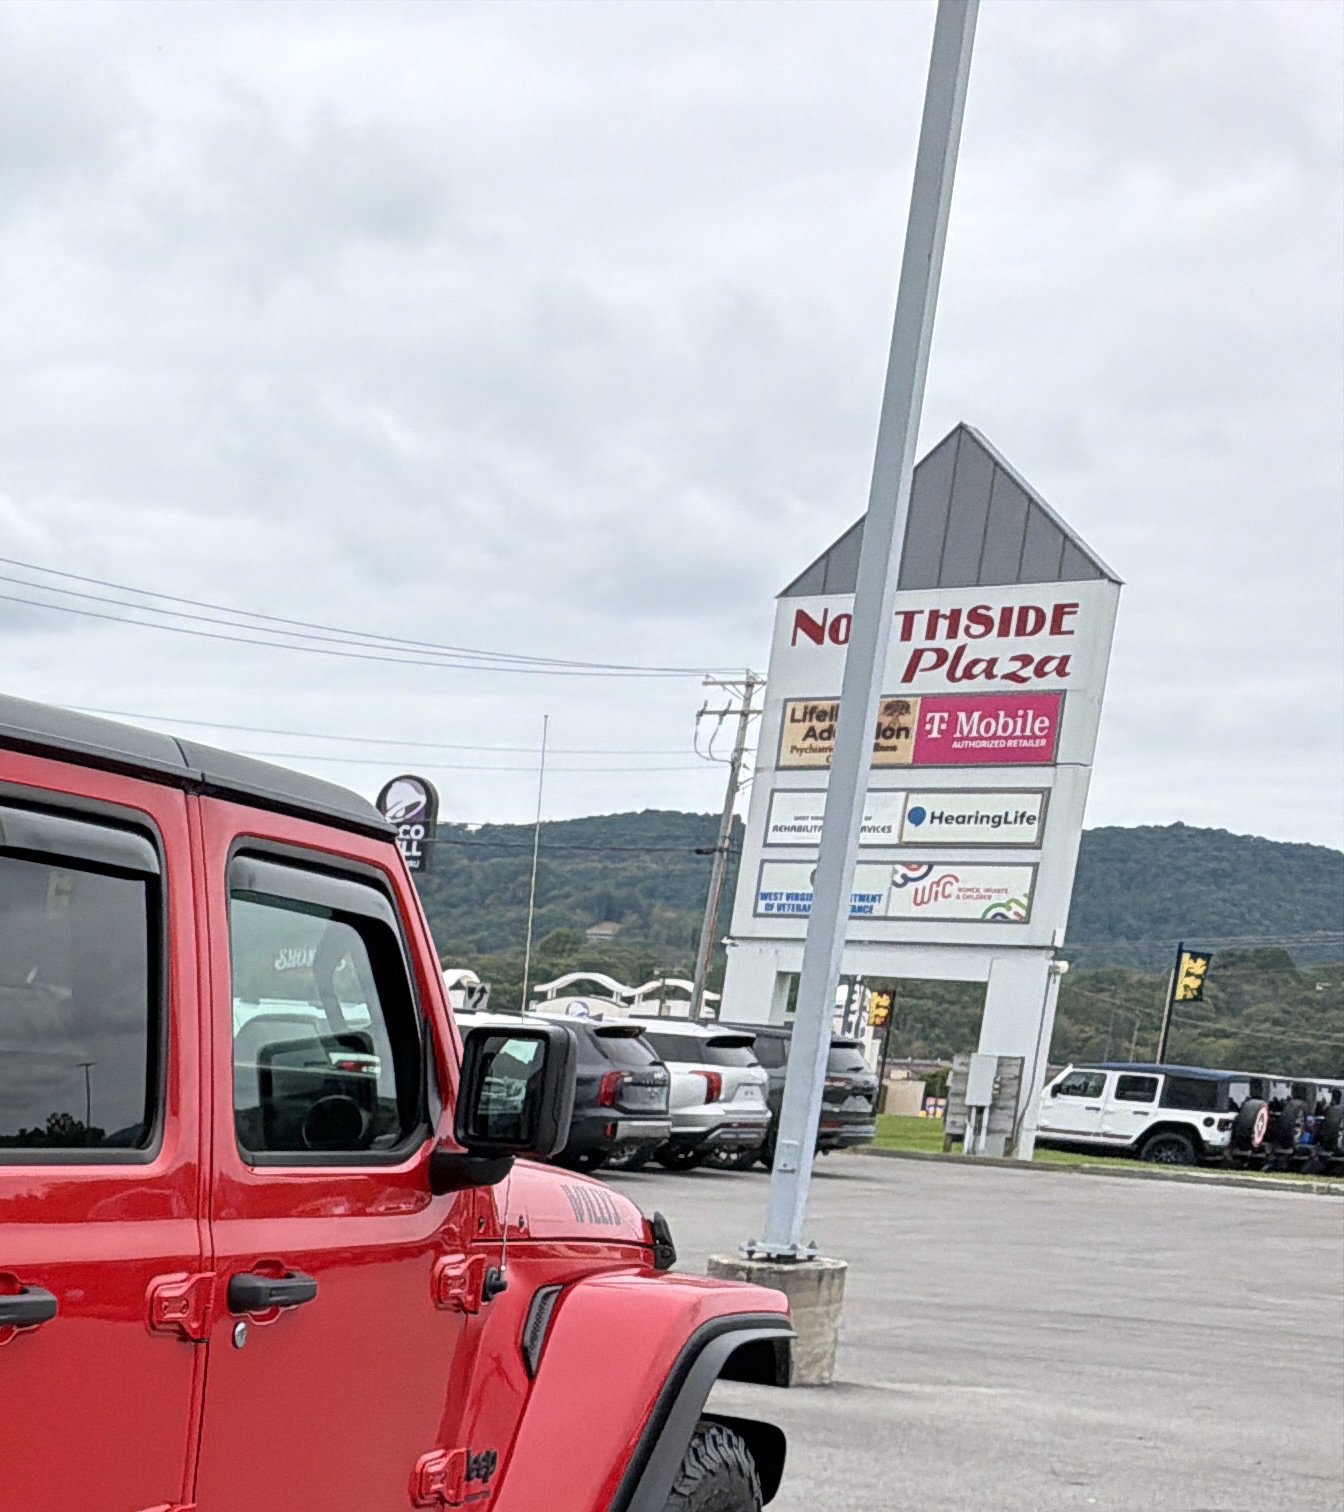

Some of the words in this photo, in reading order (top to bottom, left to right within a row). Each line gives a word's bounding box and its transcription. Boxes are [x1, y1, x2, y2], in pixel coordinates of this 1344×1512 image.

[791, 602, 1079, 646] NOTHSIDE
[900, 643, 1072, 684] Plaza
[952, 709, 1050, 738] Mobile
[952, 739, 1006, 749] AUTHORIZED
[1007, 738, 1047, 748] RETAILER
[929, 809, 1037, 828] HearingLife
[399, 824, 425, 839] CO
[401, 840, 422, 856] LL
[760, 892, 784, 901] WEST
[765, 903, 775, 912] OF
